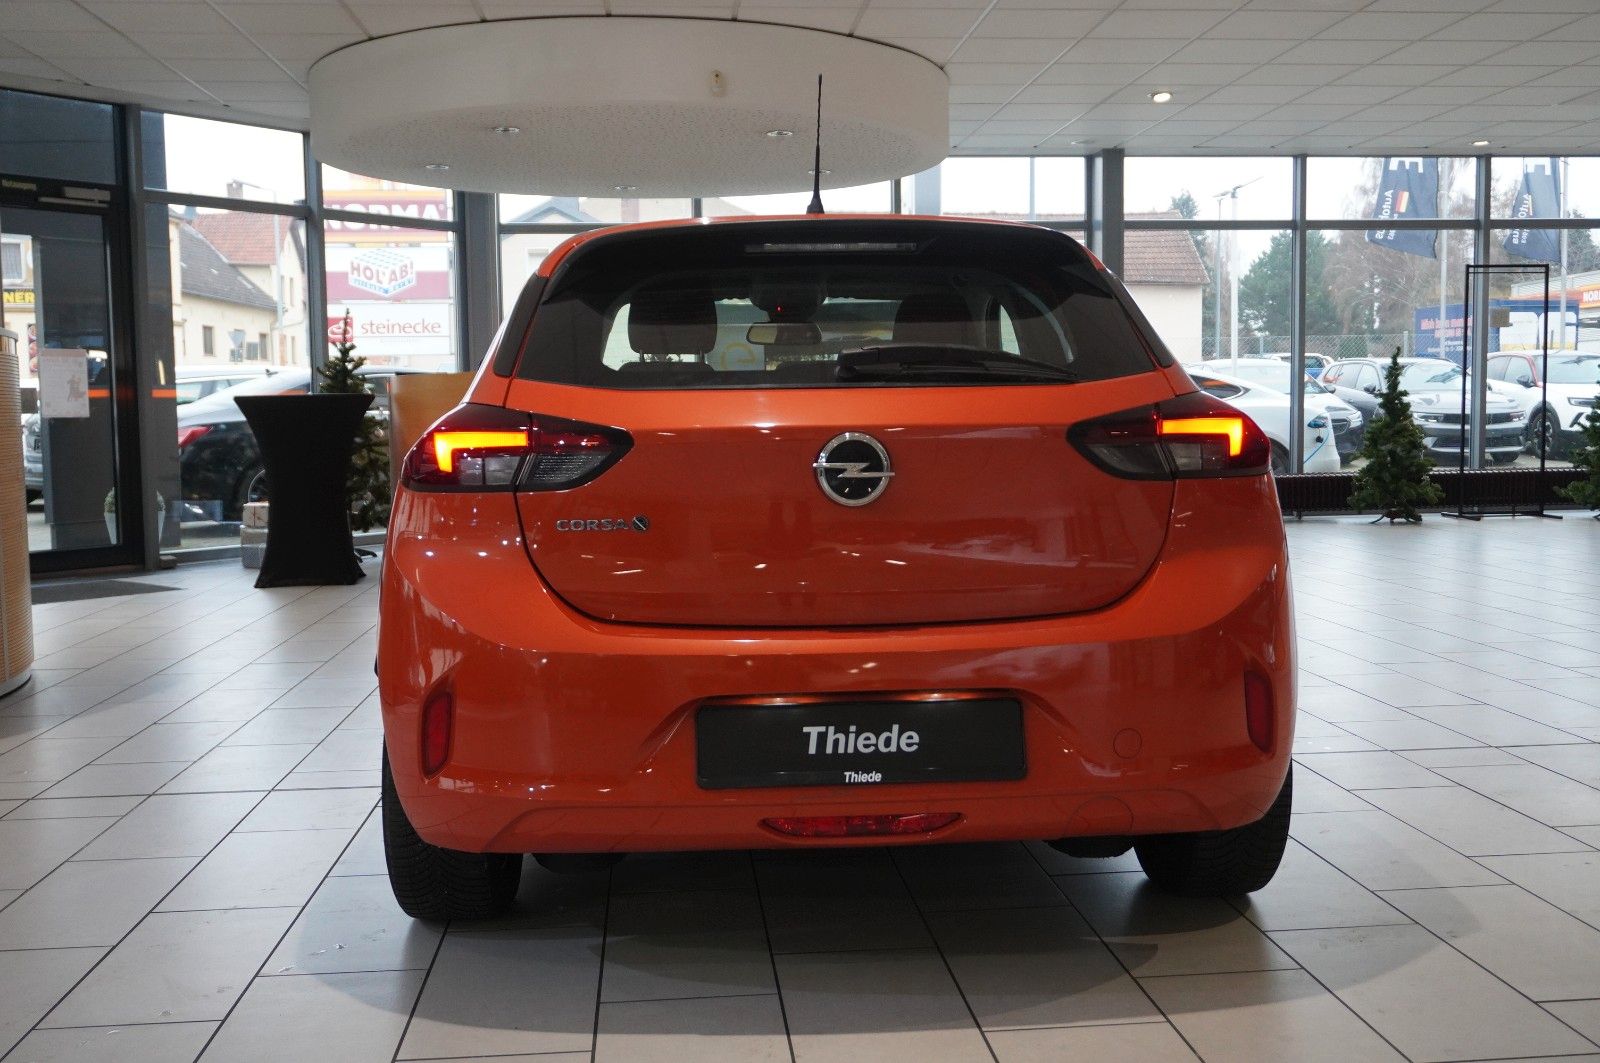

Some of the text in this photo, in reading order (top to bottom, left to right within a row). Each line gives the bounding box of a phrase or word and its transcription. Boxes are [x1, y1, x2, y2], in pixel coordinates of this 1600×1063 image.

[1583, 290, 1600, 303] NOR
[361, 318, 441, 334] steinecke
[556, 518, 628, 531] CORSA
[802, 724, 920, 755] Thiede
[843, 771, 882, 783] Thiede
